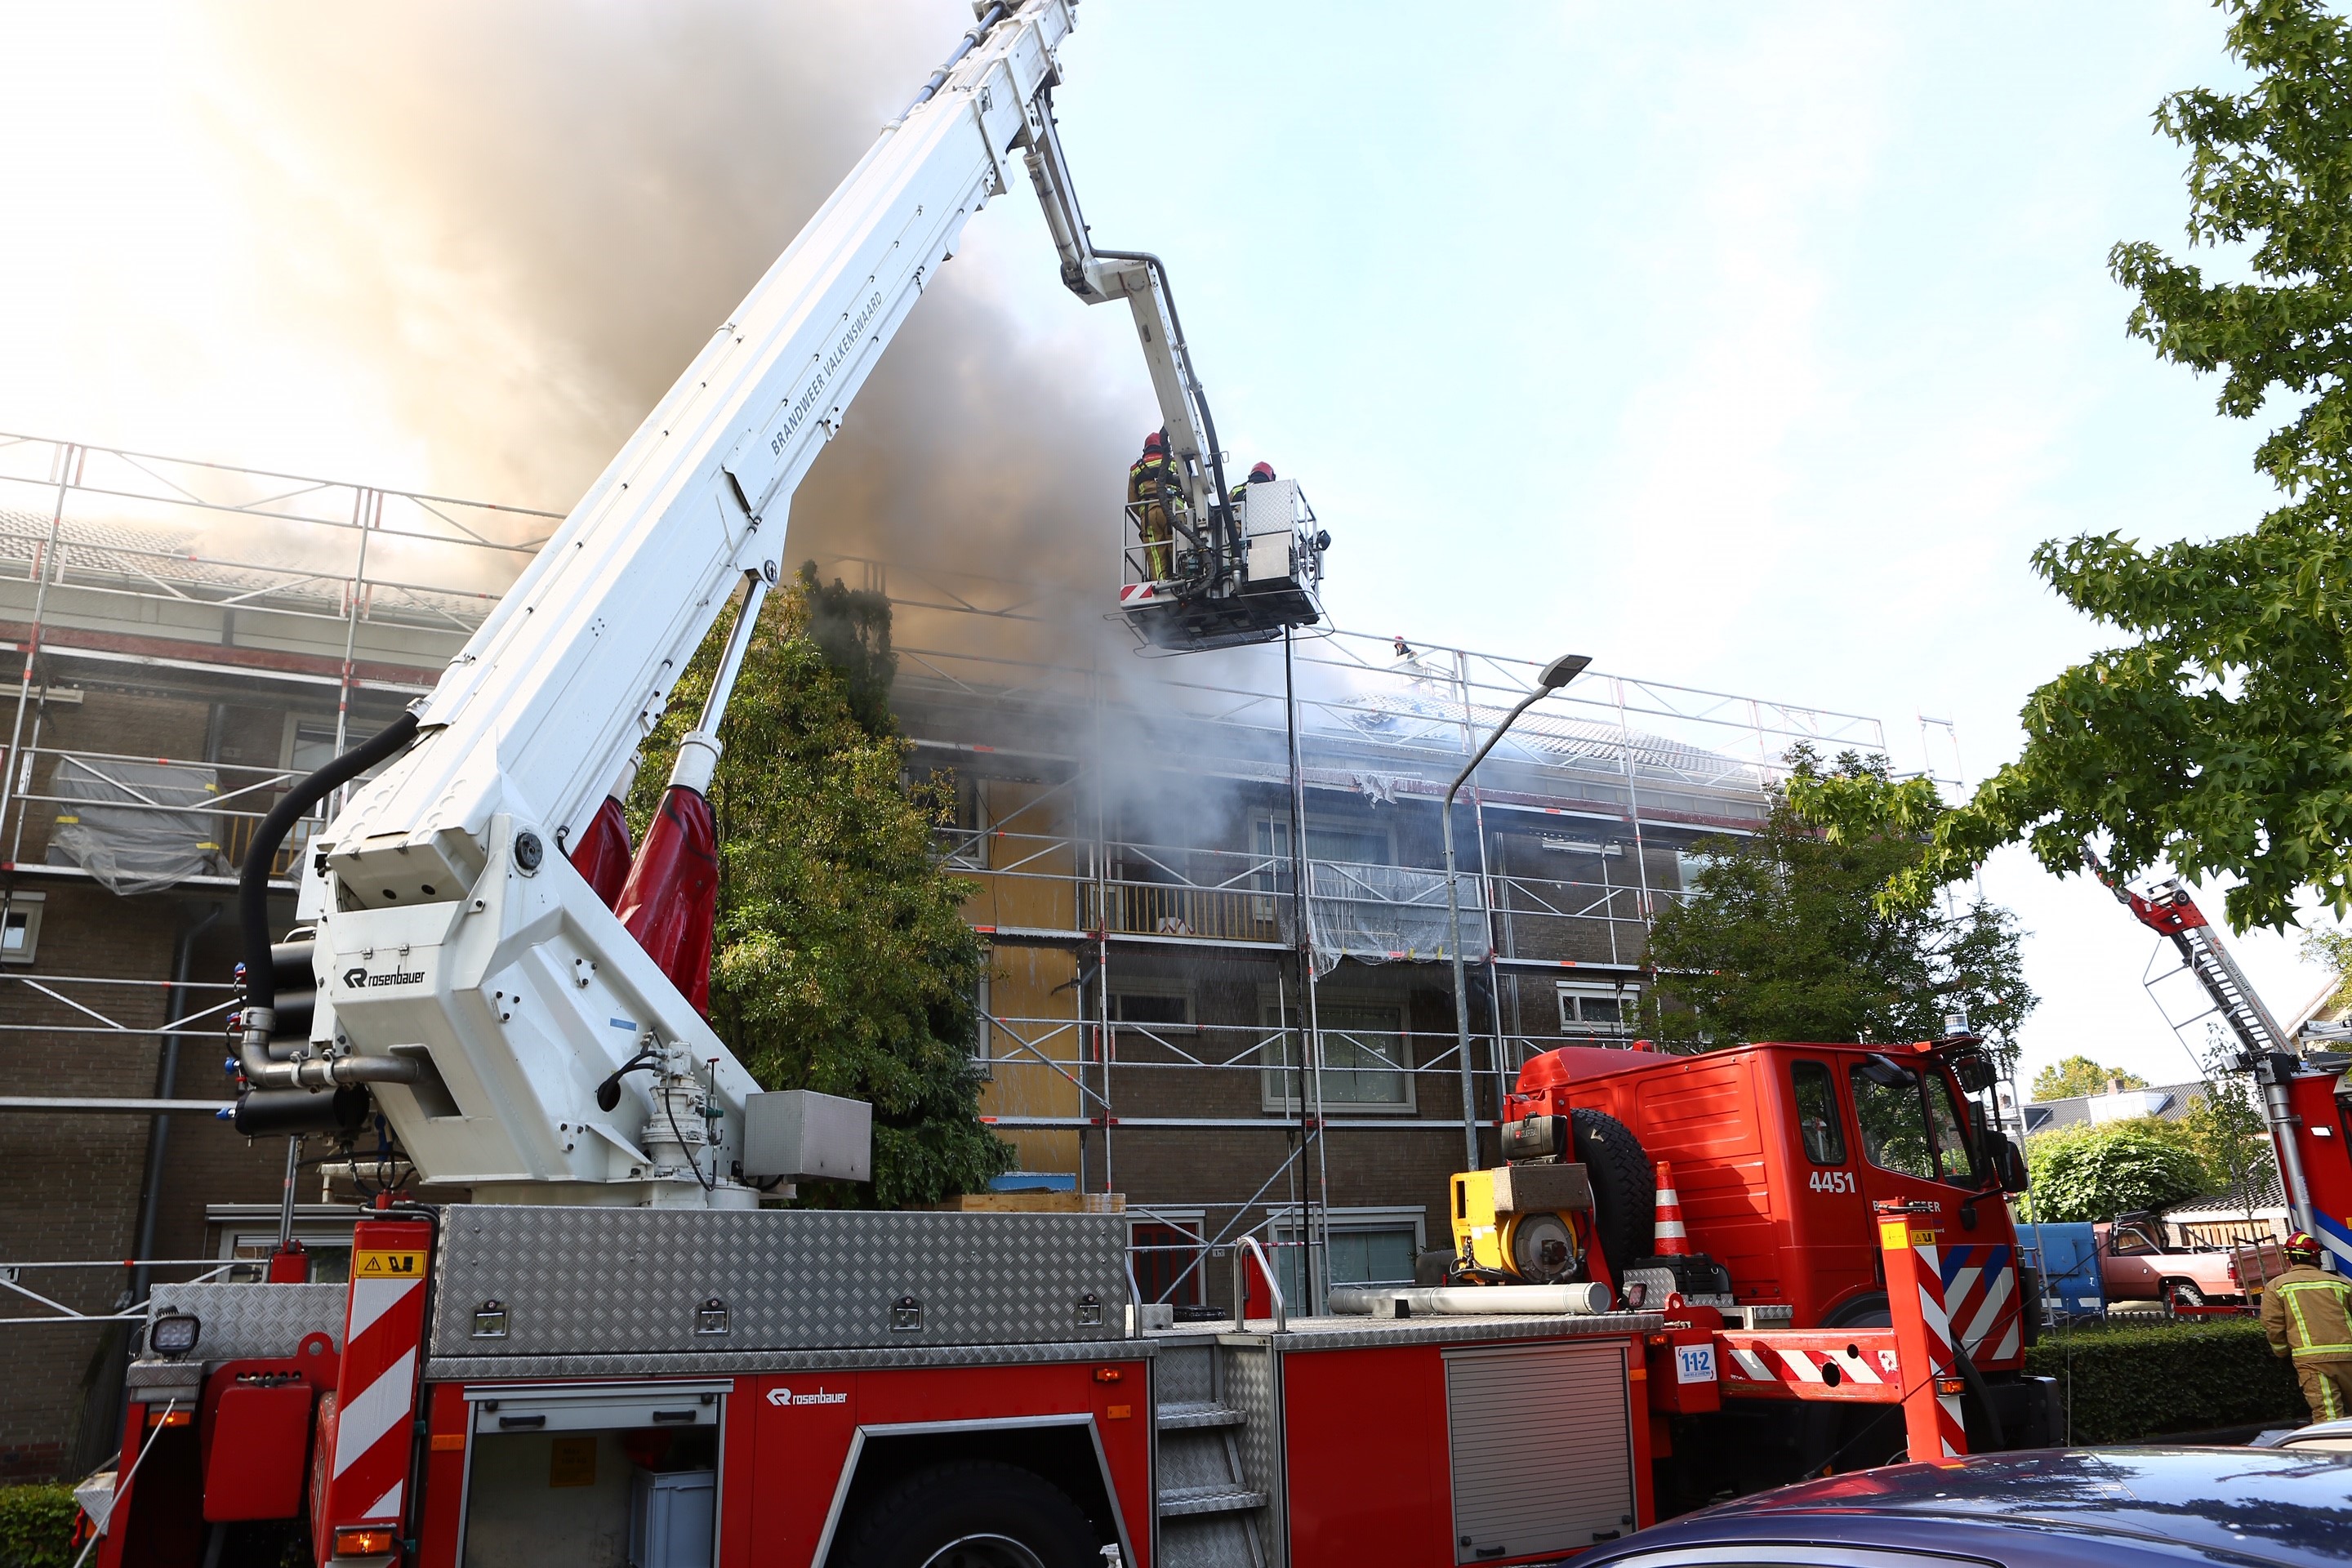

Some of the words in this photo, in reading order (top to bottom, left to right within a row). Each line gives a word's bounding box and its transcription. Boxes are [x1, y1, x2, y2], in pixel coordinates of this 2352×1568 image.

[770, 373, 826, 456] BRANDWEER
[823, 291, 882, 376] VALKENSWAARD
[368, 964, 425, 987] rosenbauer
[2227, 960, 2237, 973] Van
[2235, 973, 2251, 991] Hooff
[1809, 1171, 1855, 1193] 4451
[792, 1386, 848, 1405] rosenbauer
